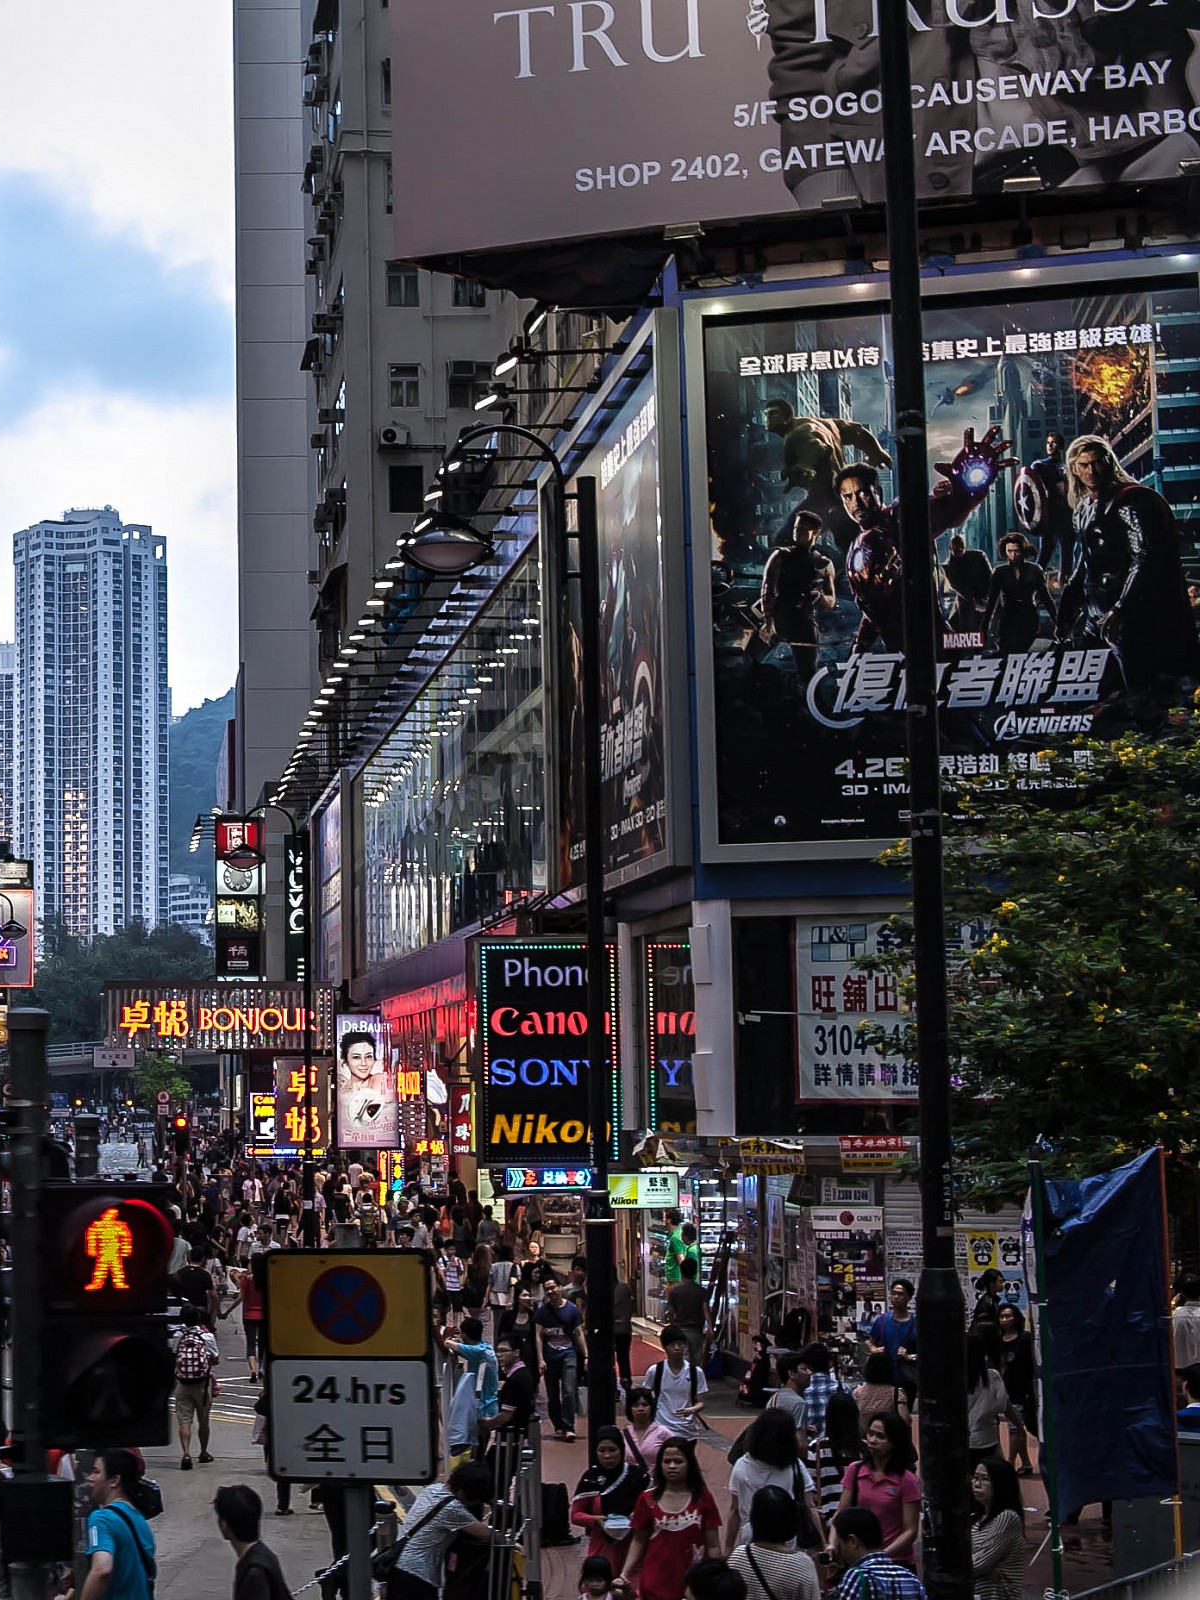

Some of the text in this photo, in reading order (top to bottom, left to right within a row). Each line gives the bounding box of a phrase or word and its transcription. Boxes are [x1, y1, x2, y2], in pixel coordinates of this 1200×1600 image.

[732, 58, 1173, 128] 5/F SOGO CAUSEWAY BAY
[574, 161, 662, 192] SHOP
[670, 152, 749, 183] 2402,
[924, 119, 1077, 158] ARCADE,
[943, 632, 984, 649] MARVEL
[833, 649, 1113, 714] 復者聯盟
[841, 784, 869, 796] 3D
[503, 957, 589, 988] Phon
[490, 1058, 611, 1087] SON
[611, 1196, 638, 1205] Nikon
[293, 1374, 407, 1405] 24 hrs
[302, 1423, 395, 1465] 全日
